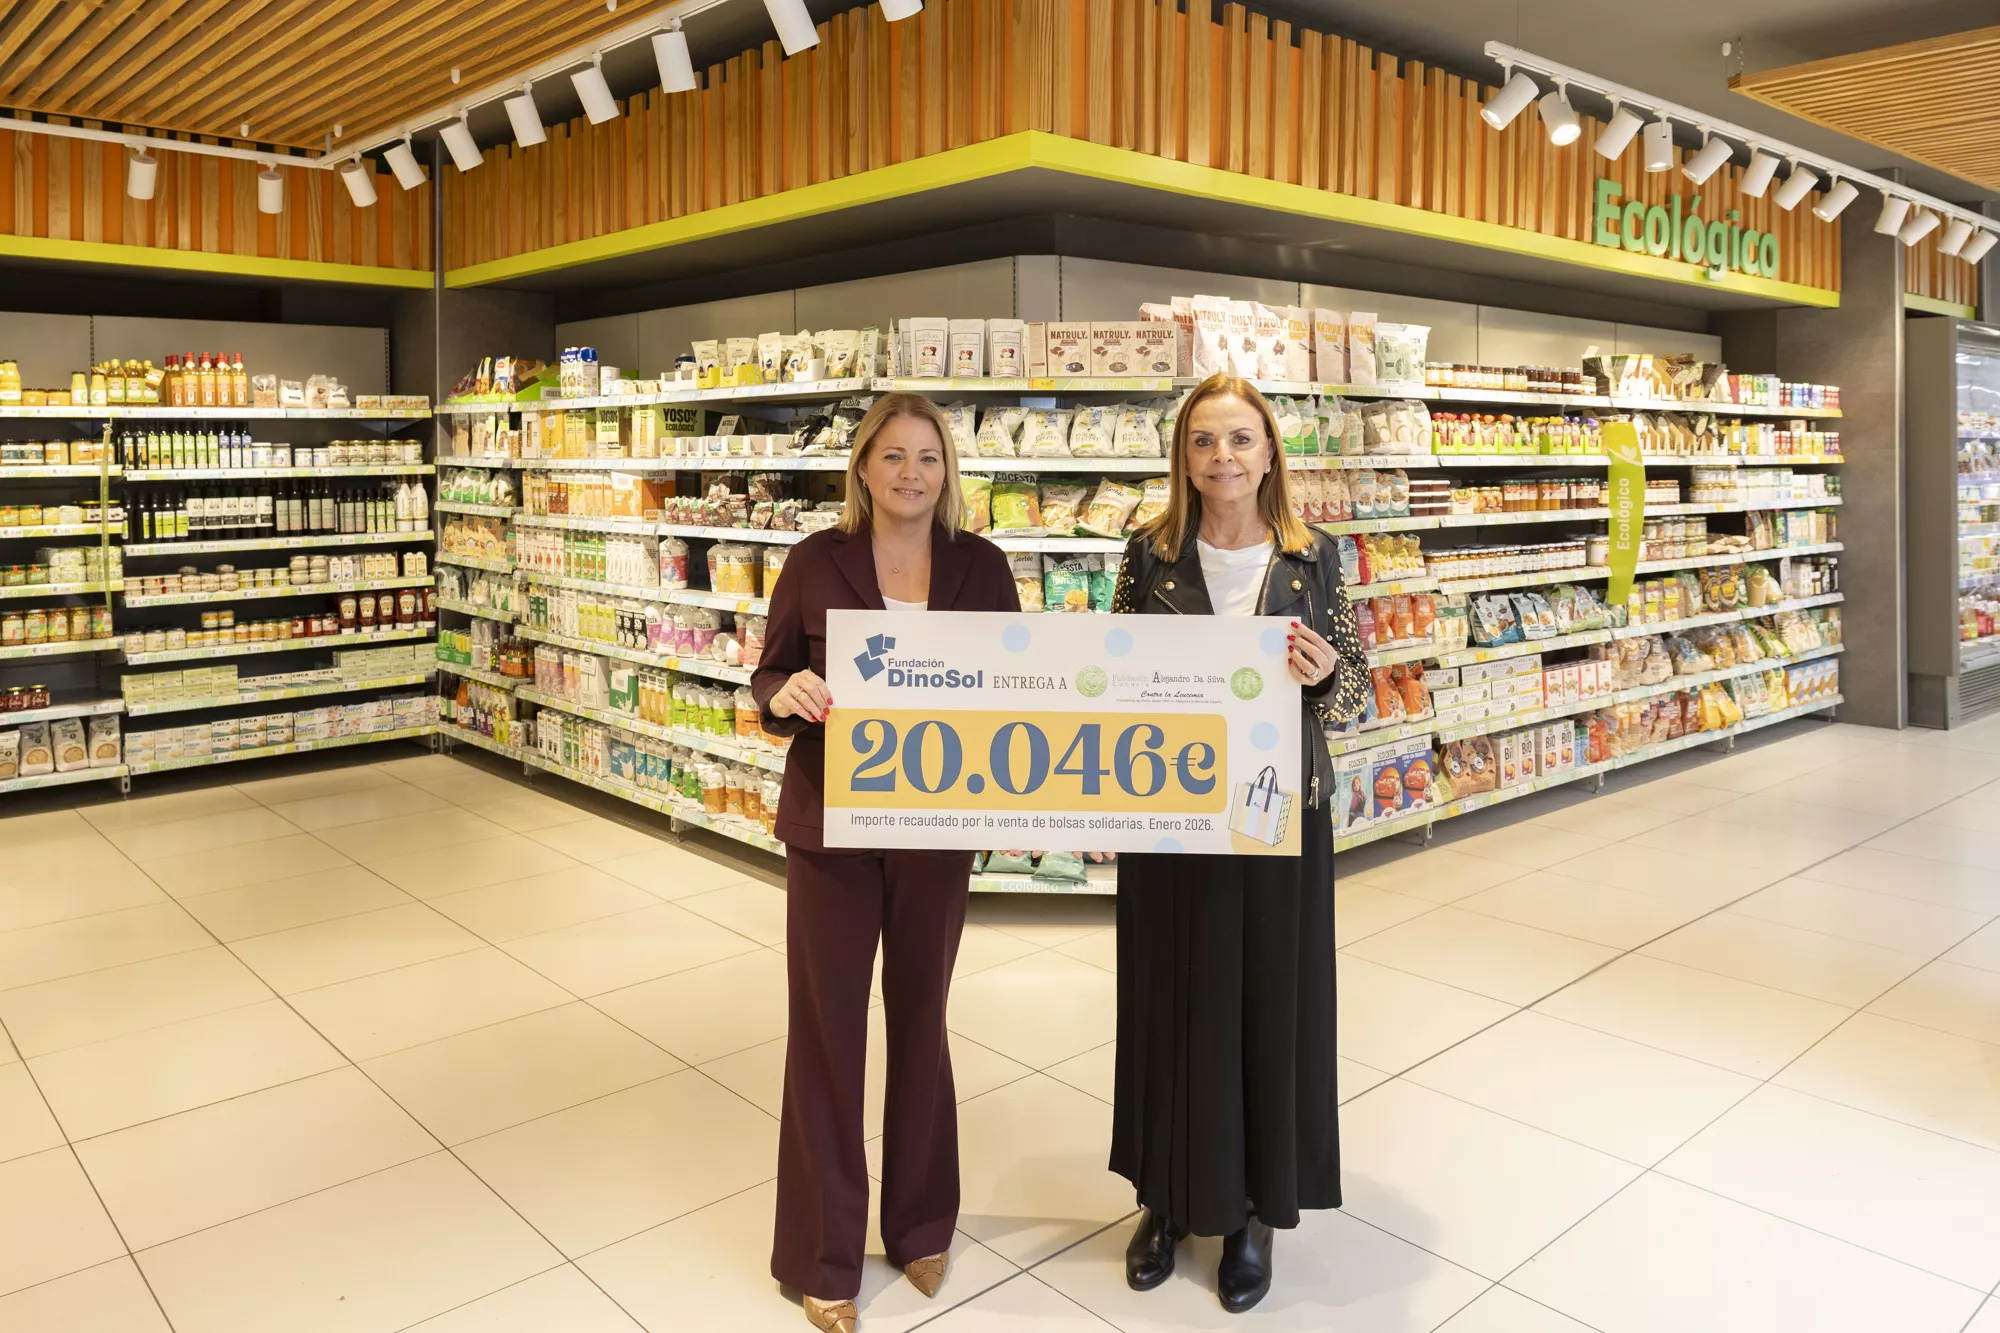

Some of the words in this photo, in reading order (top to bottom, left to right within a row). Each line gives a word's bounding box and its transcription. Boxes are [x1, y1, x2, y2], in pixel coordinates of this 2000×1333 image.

[1594, 178, 1779, 282] Ecológico
[1050, 331, 1088, 339] NATRULY.
[1093, 330, 1131, 339] NATRULY.
[1136, 330, 1174, 339] NATRULY.
[1081, 379, 1128, 390] Organic
[663, 408, 698, 422] YOSOY
[665, 422, 695, 432] ECOLÓGICO
[1616, 477, 1634, 551] Ecológico
[888, 657, 945, 668] Fundación
[887, 669, 983, 688] DinoSol
[993, 675, 1055, 690] ENTREGA
[1058, 677, 1068, 690] A
[1152, 671, 1190, 684] Alejandro
[1194, 675, 1204, 683] Da
[1207, 675, 1225, 684] Silva
[1141, 690, 1162, 698] Contra
[1173, 690, 1204, 698] Leucemia
[1407, 742, 1426, 753] ECOCESTA
[850, 718, 1216, 797] 20.046€
[1378, 749, 1397, 760] ECOCESTA
[1348, 757, 1368, 769] ECOCESTA
[851, 813, 895, 828] Importe
[899, 815, 958, 827] recaudado
[962, 817, 981, 829] por
[984, 815, 994, 827] la
[998, 817, 1028, 828] venta
[1032, 816, 1046, 828] de
[1049, 817, 1085, 829] bolsas
[1088, 817, 1145, 829] solidarias.
[1150, 818, 1181, 830] Enero
[1184, 819, 1214, 831] 2026.
